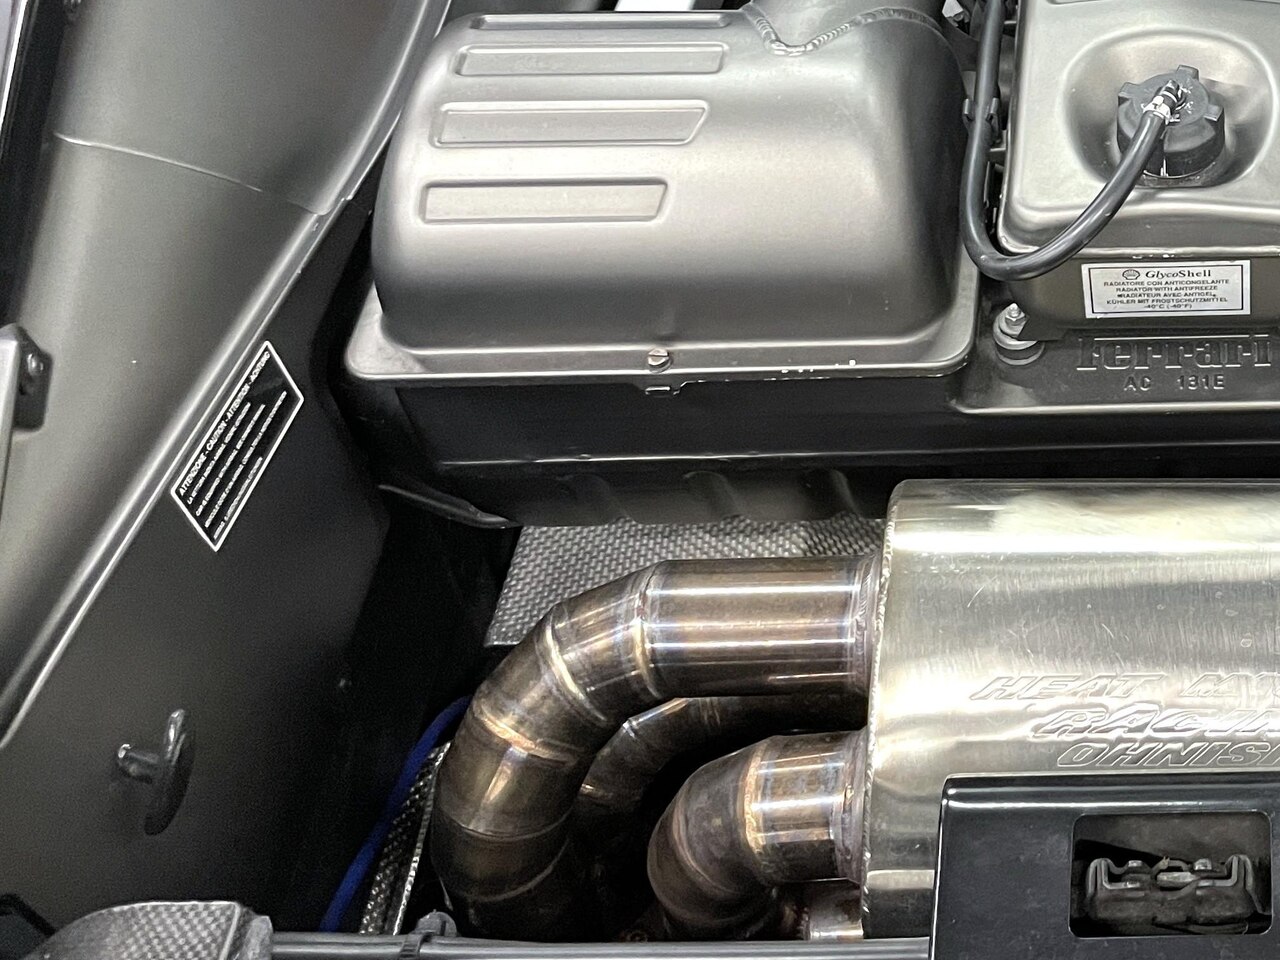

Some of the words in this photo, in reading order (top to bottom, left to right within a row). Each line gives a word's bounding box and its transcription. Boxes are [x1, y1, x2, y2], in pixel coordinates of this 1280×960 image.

[1145, 270, 1211, 279] GlycoShell
[1077, 334, 1271, 371] Ferrari
[1176, 373, 1225, 390] 131E
[206, 420, 227, 451] CAUTION
[970, 672, 1167, 700] HEAT
